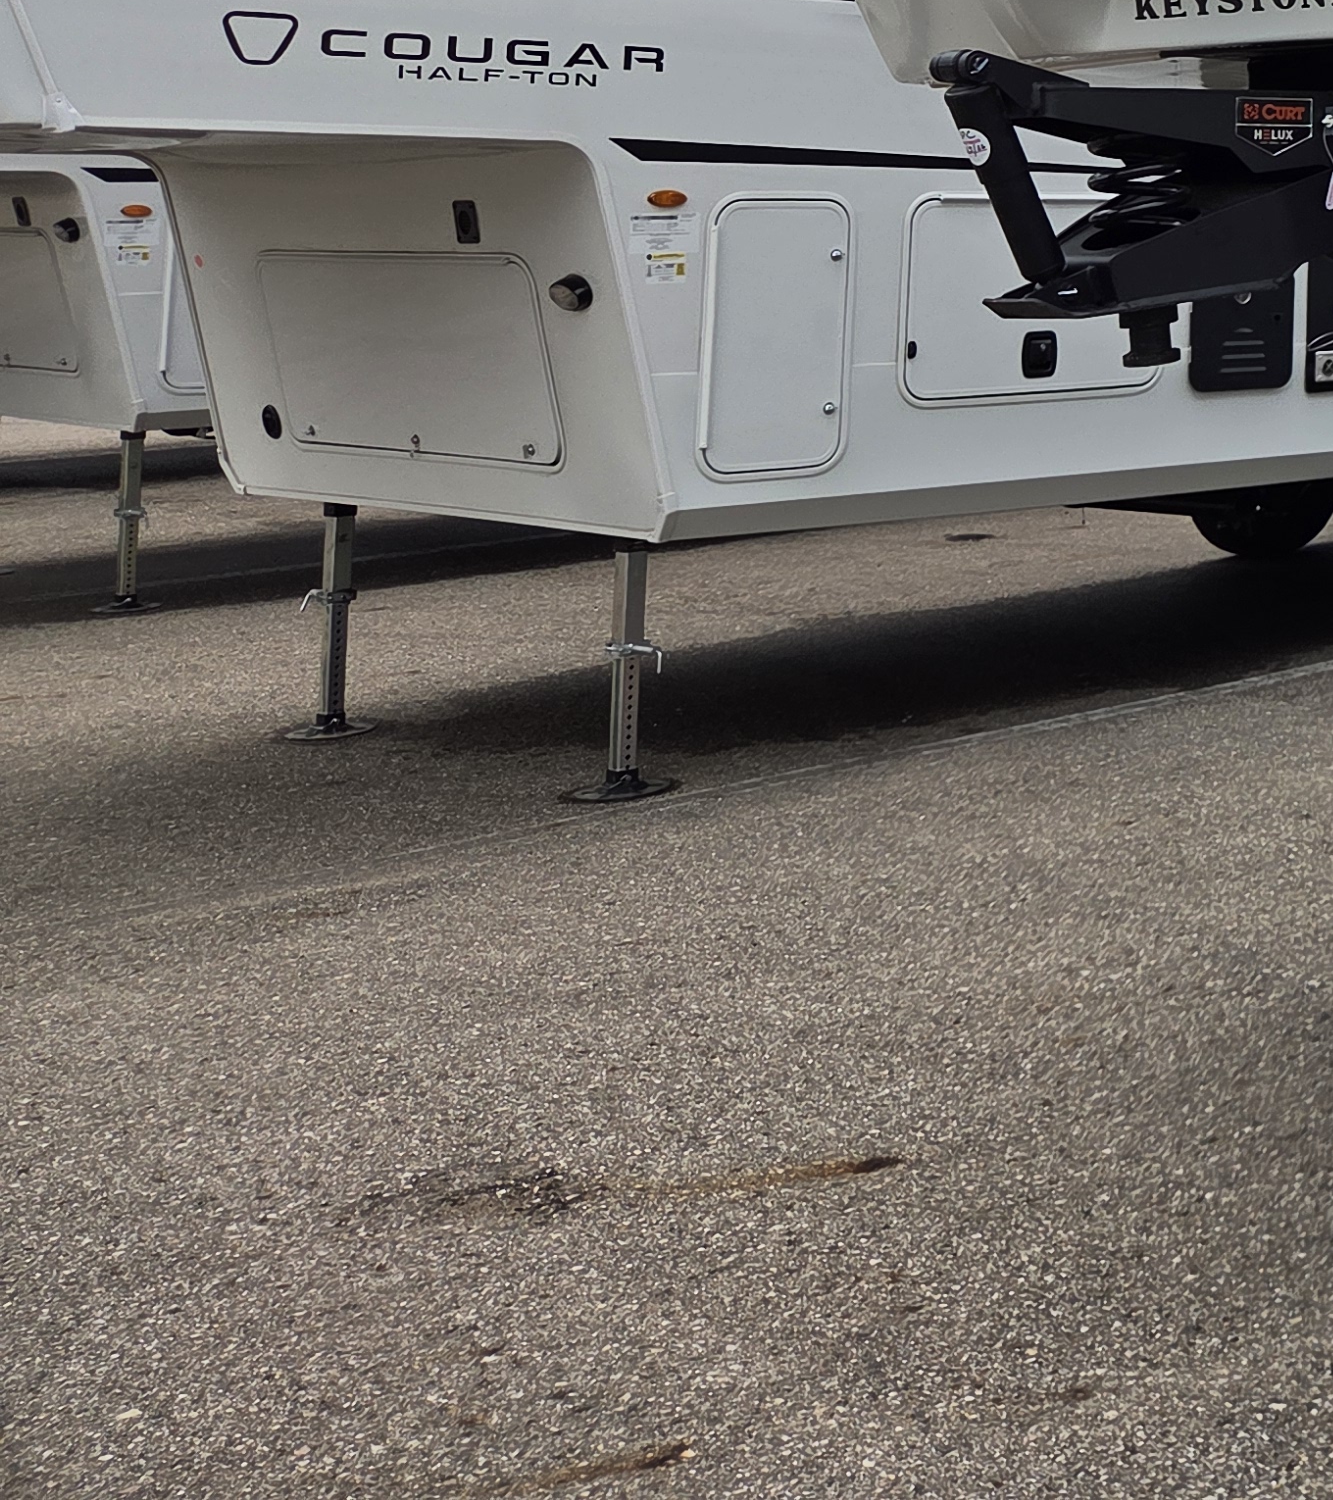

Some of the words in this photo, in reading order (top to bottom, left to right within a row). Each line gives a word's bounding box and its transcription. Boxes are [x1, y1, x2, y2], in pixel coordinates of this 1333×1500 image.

[319, 28, 666, 73] COUGAR
[398, 64, 599, 88] HALF-TON
[1253, 128, 1294, 141] HELUX
